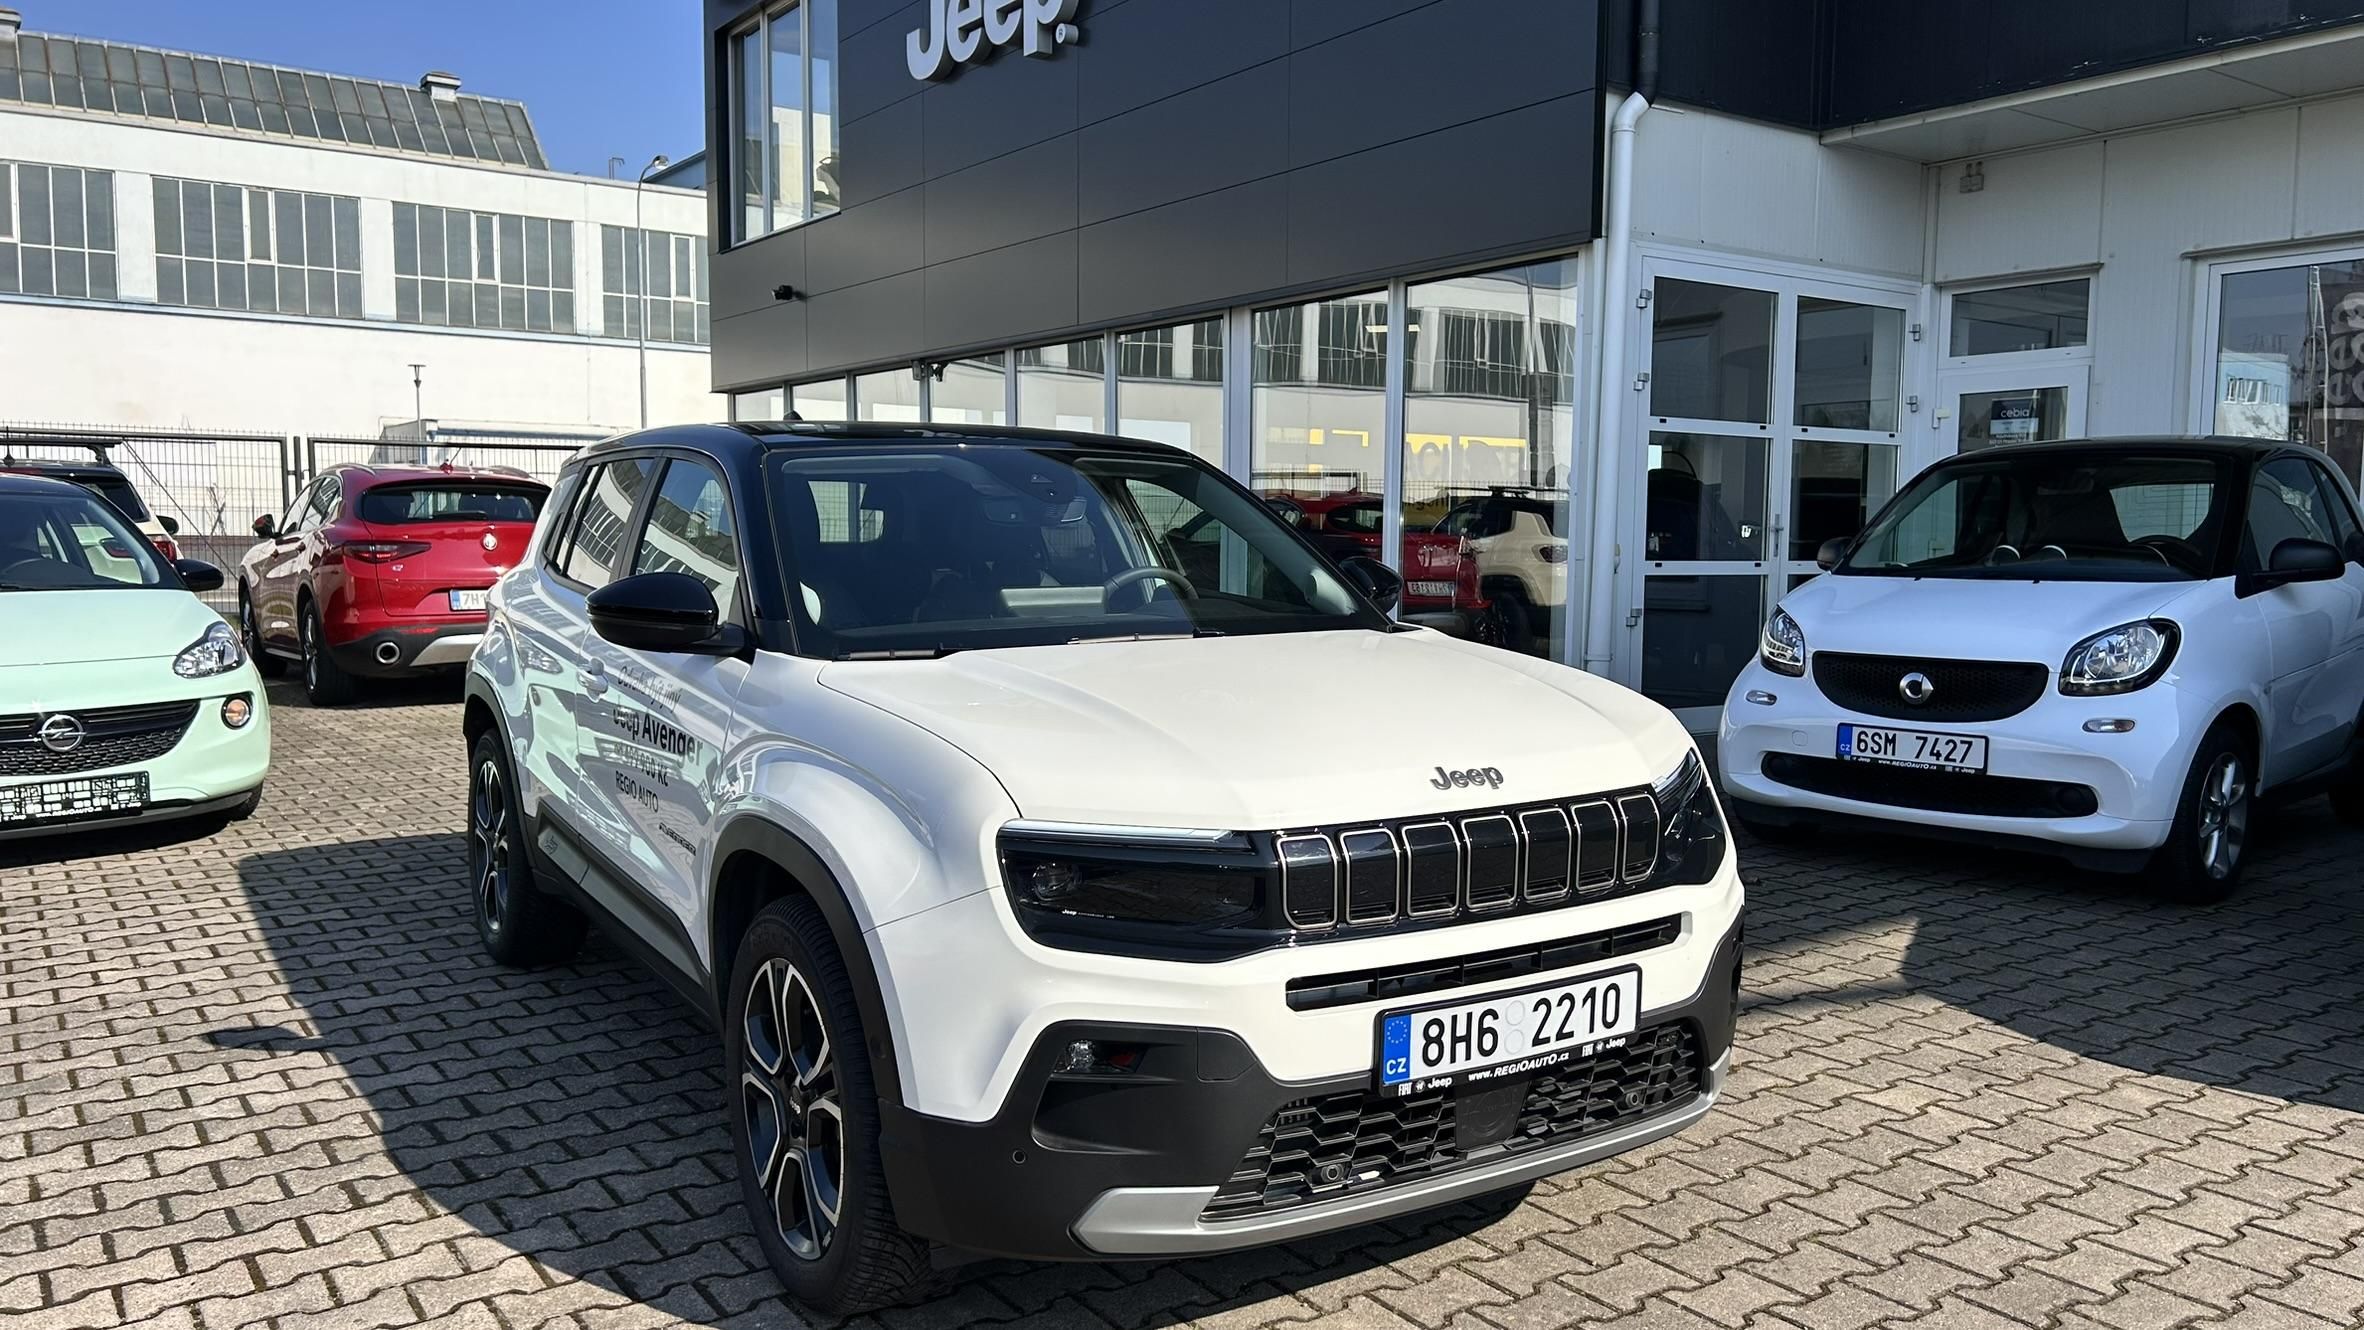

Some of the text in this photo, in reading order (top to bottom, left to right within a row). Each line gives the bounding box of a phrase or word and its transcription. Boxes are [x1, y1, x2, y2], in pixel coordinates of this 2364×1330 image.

[2000, 408, 2030, 418] cebia
[641, 712, 704, 769] Avenger
[1856, 730, 1973, 764] 6SM 7427
[615, 770, 659, 813] REGIO AUTO
[1429, 766, 1504, 790] Jeep
[1421, 982, 1621, 1067] 8H6 2210
[1386, 1057, 1407, 1076] CZ
[1427, 1077, 1453, 1089] Jeep
[1468, 1052, 1570, 1082] www.REGIOAUTO.cz
[1605, 1037, 1626, 1049] Jeep
